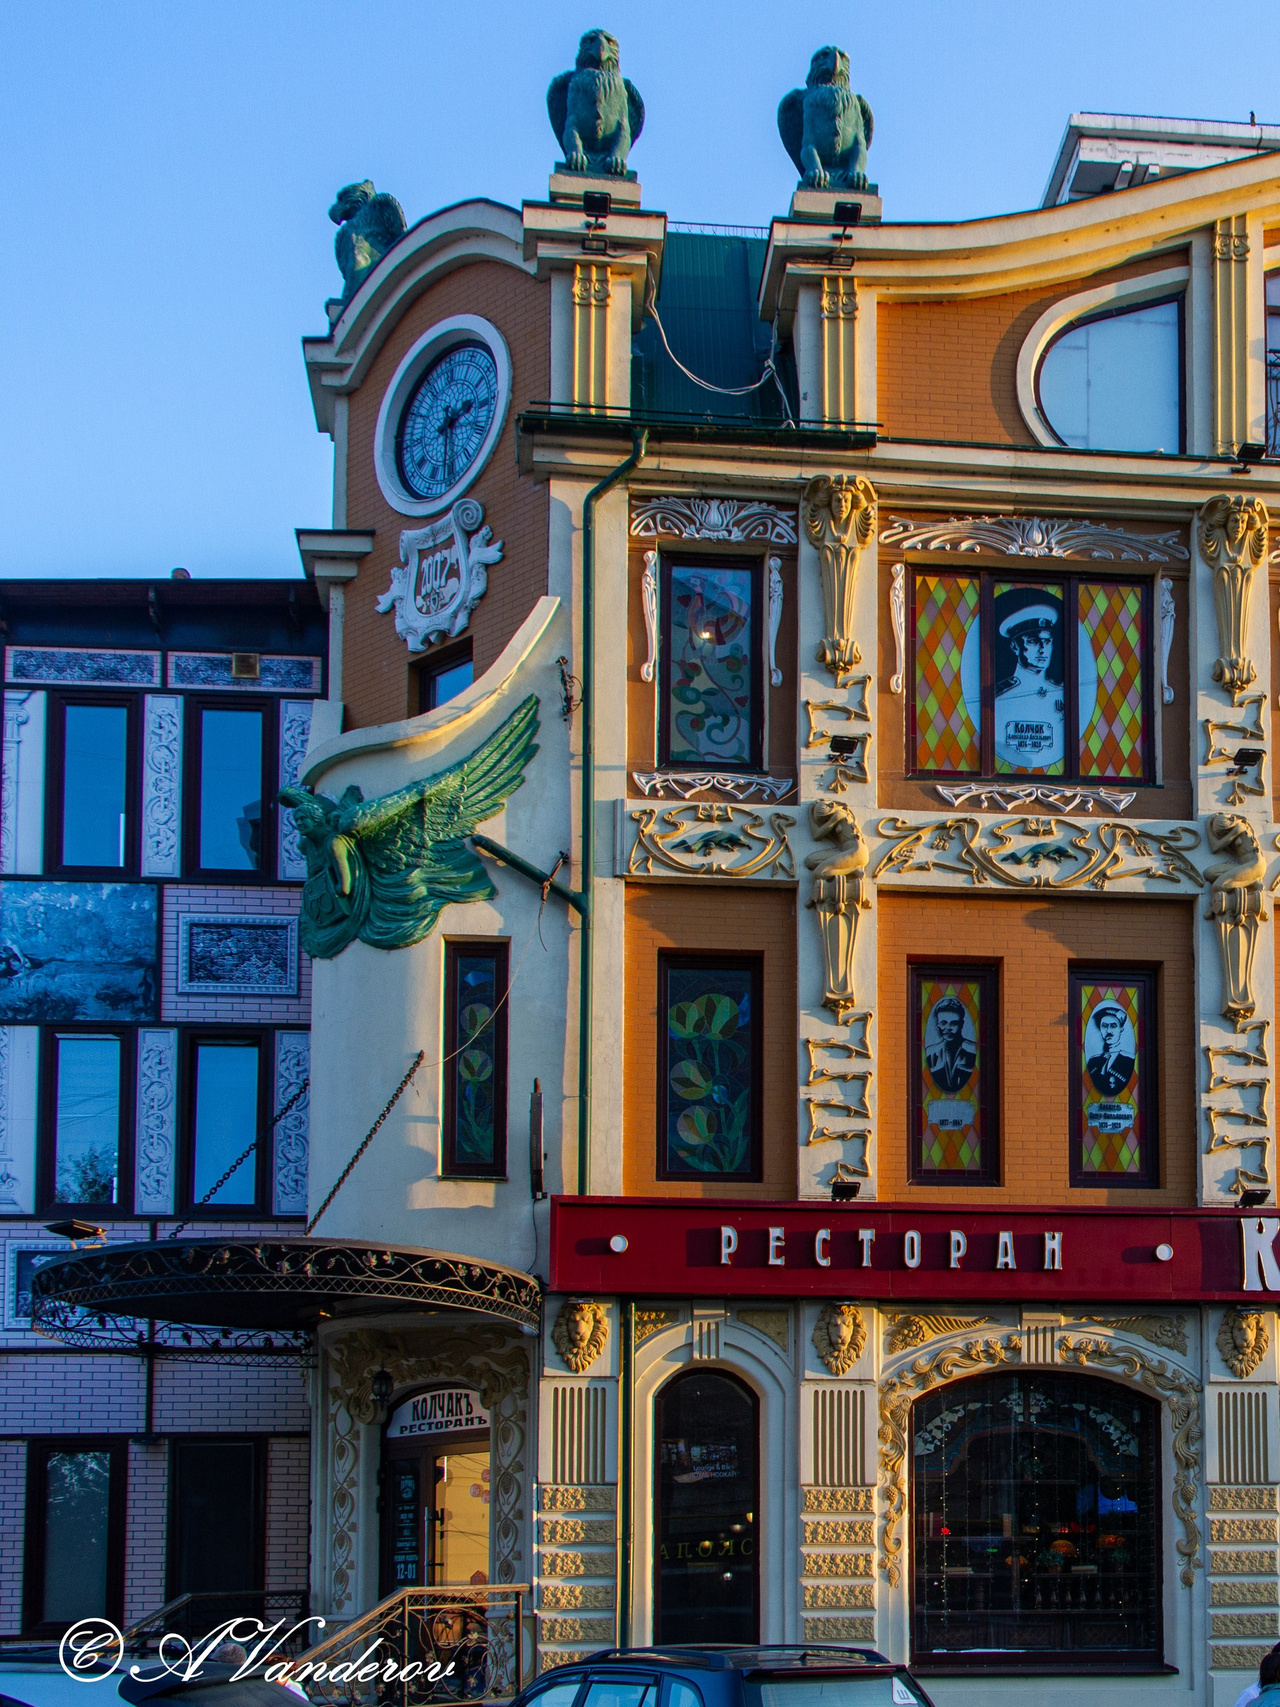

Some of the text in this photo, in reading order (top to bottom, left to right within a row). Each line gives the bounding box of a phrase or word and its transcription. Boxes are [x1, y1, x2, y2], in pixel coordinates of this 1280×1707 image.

[1014, 722, 1044, 734] Колчак
[720, 1224, 1064, 1272] РЕСТОРАН
[412, 1392, 474, 1422] КОЛЧАКЪ
[400, 1415, 488, 1435] РЕСТОРАНЪ
[396, 1563, 416, 1579] 12-01
